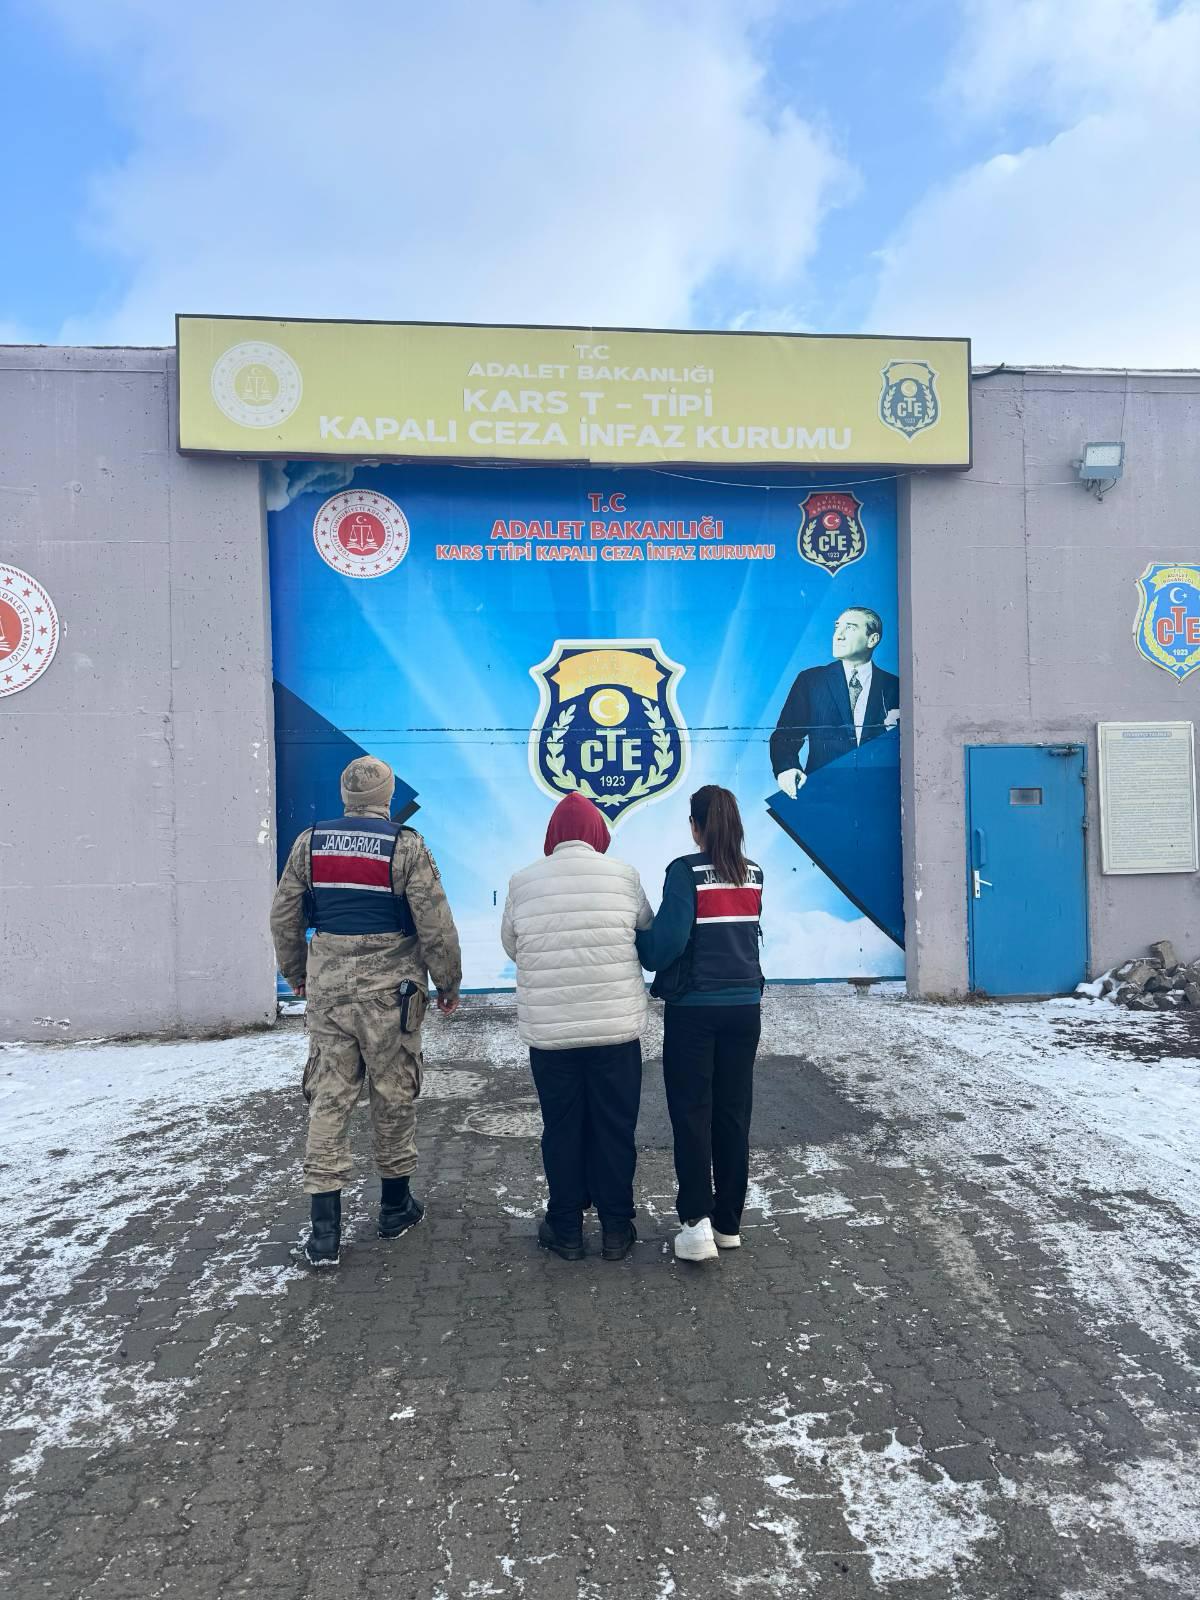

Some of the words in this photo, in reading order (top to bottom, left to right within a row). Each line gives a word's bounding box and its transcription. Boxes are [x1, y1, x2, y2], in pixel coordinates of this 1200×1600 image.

[467, 361, 570, 379] ADALET
[577, 364, 715, 384] BAKANLIĞI
[463, 388, 569, 414] KARS
[580, 393, 604, 415] T
[643, 386, 713, 417] TİPİ
[897, 397, 923, 417] CTE
[319, 415, 457, 443] KAPALI
[468, 419, 568, 446] CEZA
[579, 416, 686, 448] İNFAZ
[696, 425, 852, 451] KURUMU
[588, 492, 626, 513] T.C
[491, 519, 585, 540] ADALET
[590, 515, 724, 541] BAKANLIĞI
[436, 544, 484, 561] KARS
[485, 545, 496, 561] T
[498, 541, 532, 561] TİPİ
[536, 545, 598, 562] KAPALI
[600, 545, 645, 562] CEZA
[646, 541, 696, 561] İNFAZ
[699, 543, 776, 560] KURUMU
[818, 530, 847, 552] CTE
[580, 727, 642, 773] CTE
[599, 775, 626, 787] 1923
[321, 834, 381, 855] JANDARMA
